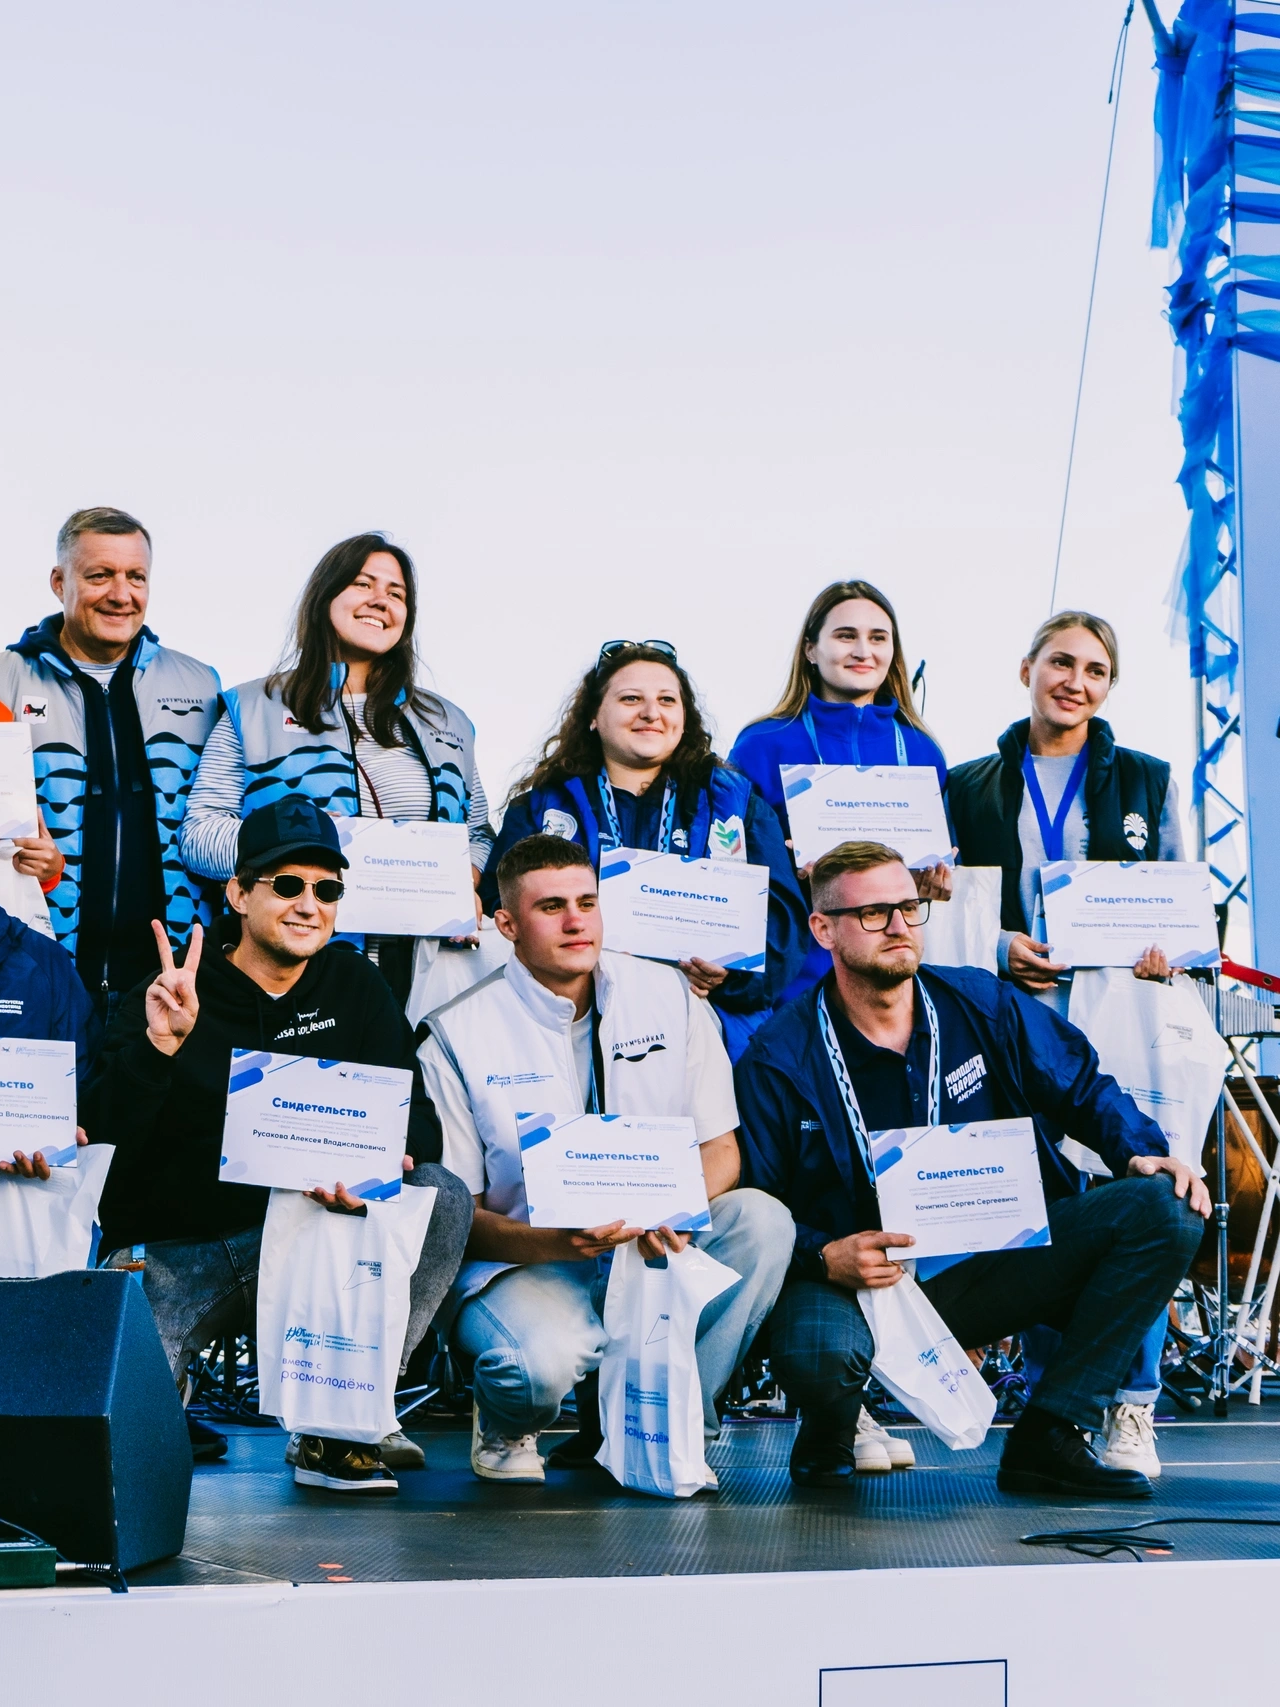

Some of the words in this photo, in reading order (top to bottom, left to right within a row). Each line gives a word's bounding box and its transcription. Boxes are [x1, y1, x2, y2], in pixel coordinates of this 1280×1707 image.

[825, 799, 909, 809] Свидетельство
[363, 855, 439, 869] Свидетельство
[385, 886, 418, 895] Екатерины
[419, 887, 456, 896] Николаевны
[640, 884, 729, 904] Свидетельство
[1085, 895, 1174, 905] Свидетельство
[675, 915, 699, 926] Ирины
[700, 919, 740, 930] Сергеевны
[944, 1053, 987, 1088] МОЛОДАЯ
[947, 1064, 987, 1099] ГВАРДИЯ
[272, 1097, 367, 1119] Свидетельство
[5, 1111, 70, 1121] Владиславовича
[252, 1129, 289, 1142] Русакова
[290, 1133, 322, 1144] Алексея
[323, 1138, 387, 1152] Владиславовича
[565, 1150, 660, 1162] Свидетельство
[917, 1165, 1005, 1181] Свидетельство
[562, 1179, 595, 1187] Власова
[626, 1181, 677, 1189] Николаевича
[915, 1202, 949, 1211] Кочигина
[950, 1199, 976, 1209] Сергея
[976, 1196, 1019, 1207] Сергеевича
[282, 1358, 313, 1368] вместе
[316, 1362, 322, 1370] с
[280, 1370, 375, 1392] росмолодёжь
